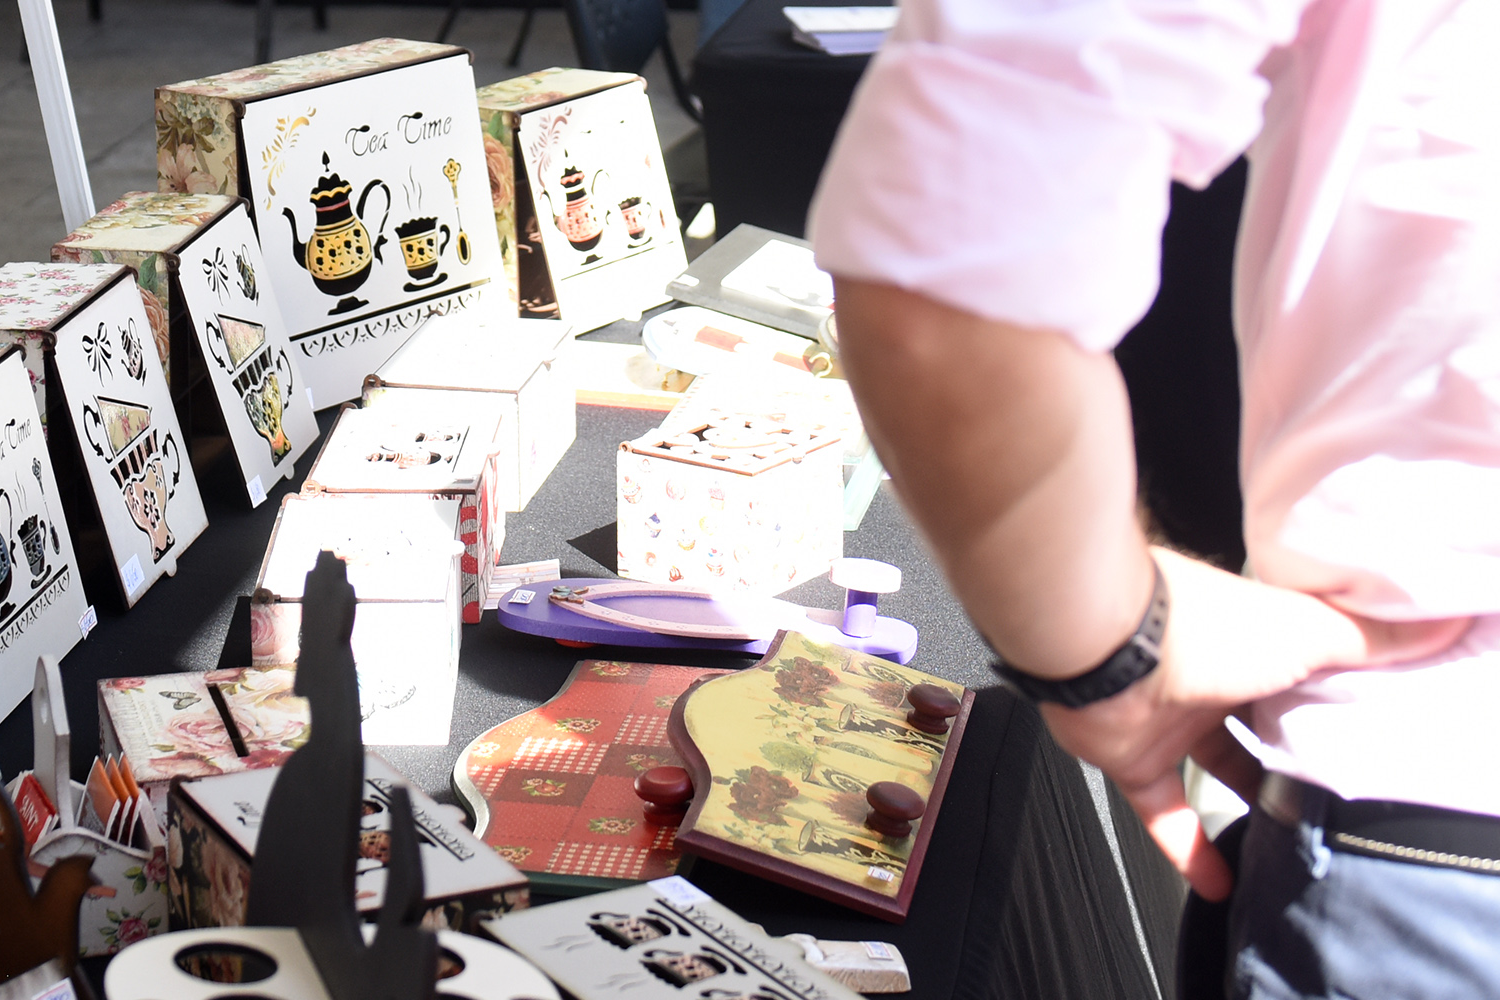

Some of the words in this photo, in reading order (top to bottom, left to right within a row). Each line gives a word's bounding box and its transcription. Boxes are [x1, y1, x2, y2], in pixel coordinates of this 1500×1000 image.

[345, 125, 389, 157] Tea
[397, 111, 452, 144] Time
[4, 418, 32, 450] Time
